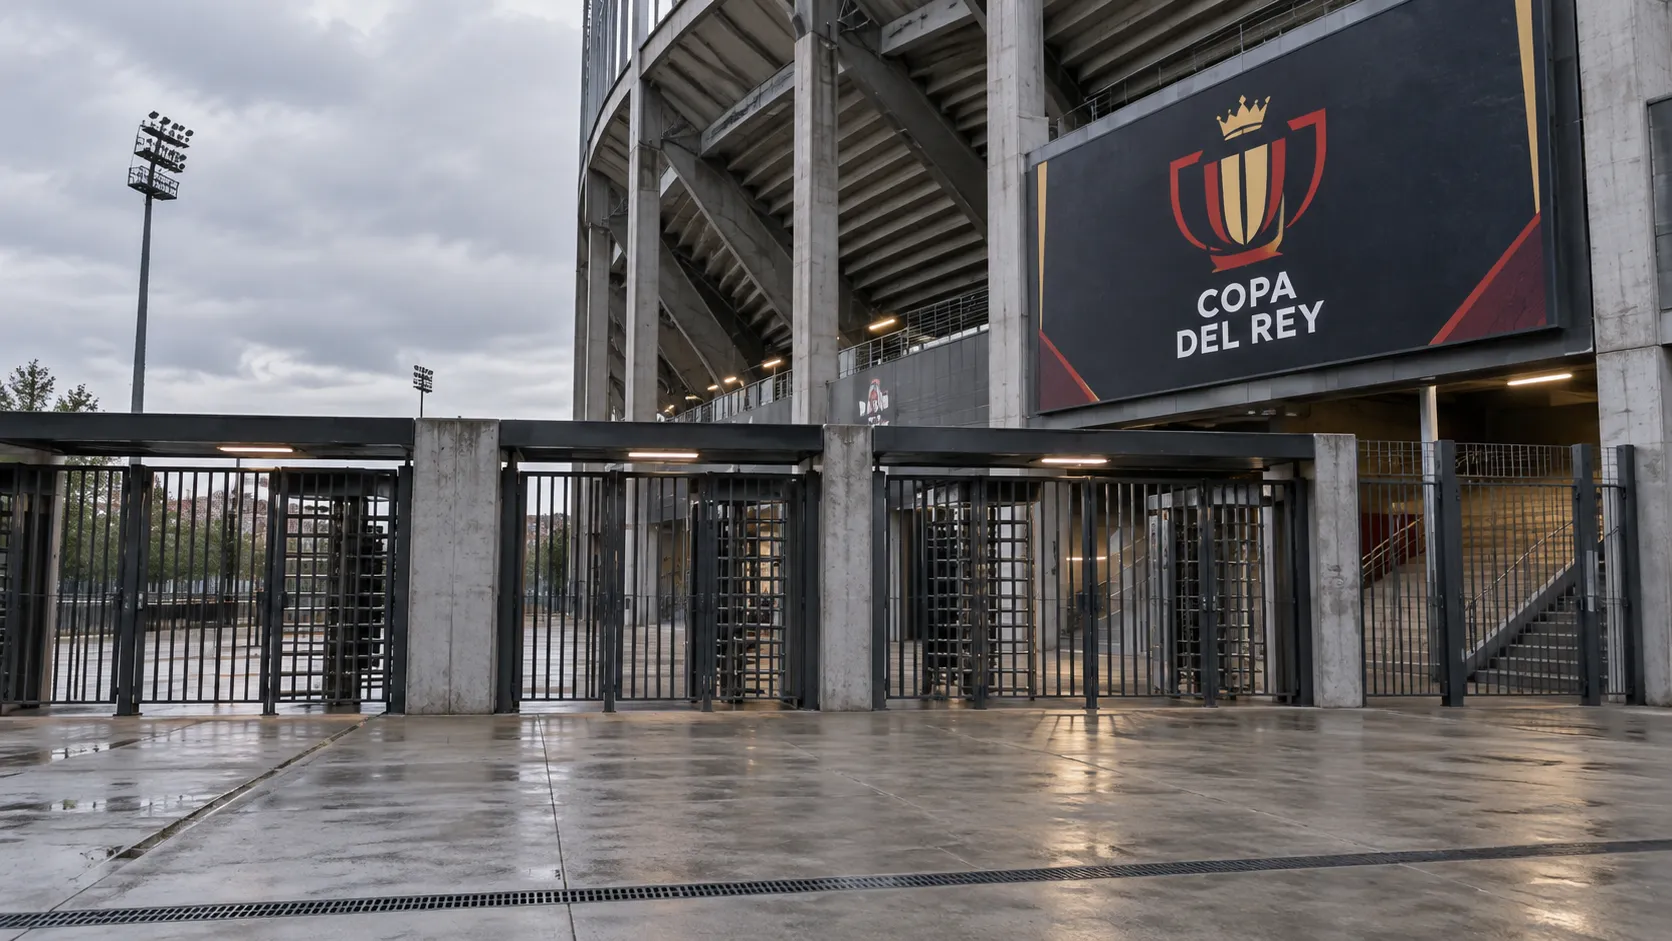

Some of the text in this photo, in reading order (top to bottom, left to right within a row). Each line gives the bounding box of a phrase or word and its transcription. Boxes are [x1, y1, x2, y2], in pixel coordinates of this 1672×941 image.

[1197, 270, 1297, 318] COPA
[1176, 299, 1325, 359] DEL REY
